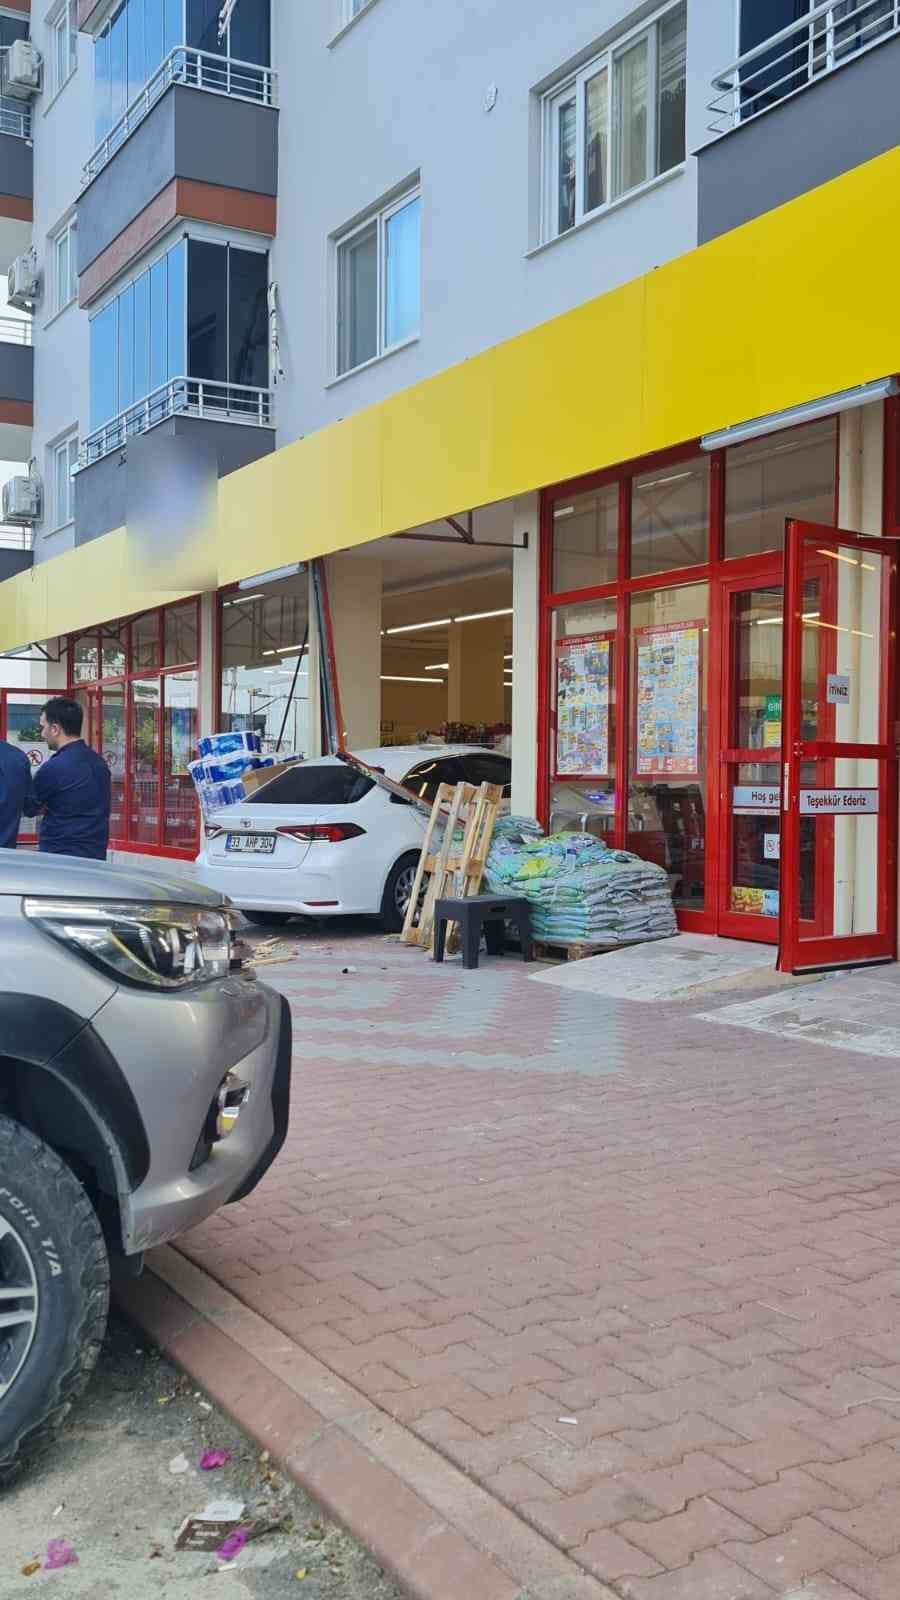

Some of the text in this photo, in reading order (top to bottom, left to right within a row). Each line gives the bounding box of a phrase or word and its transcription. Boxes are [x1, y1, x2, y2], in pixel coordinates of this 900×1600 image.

[752, 791, 766, 803] Hoş
[807, 794, 867, 808] Teşekkür Ederiz
[231, 837, 240, 847] 33
[40, 1236, 62, 1277] T/A
